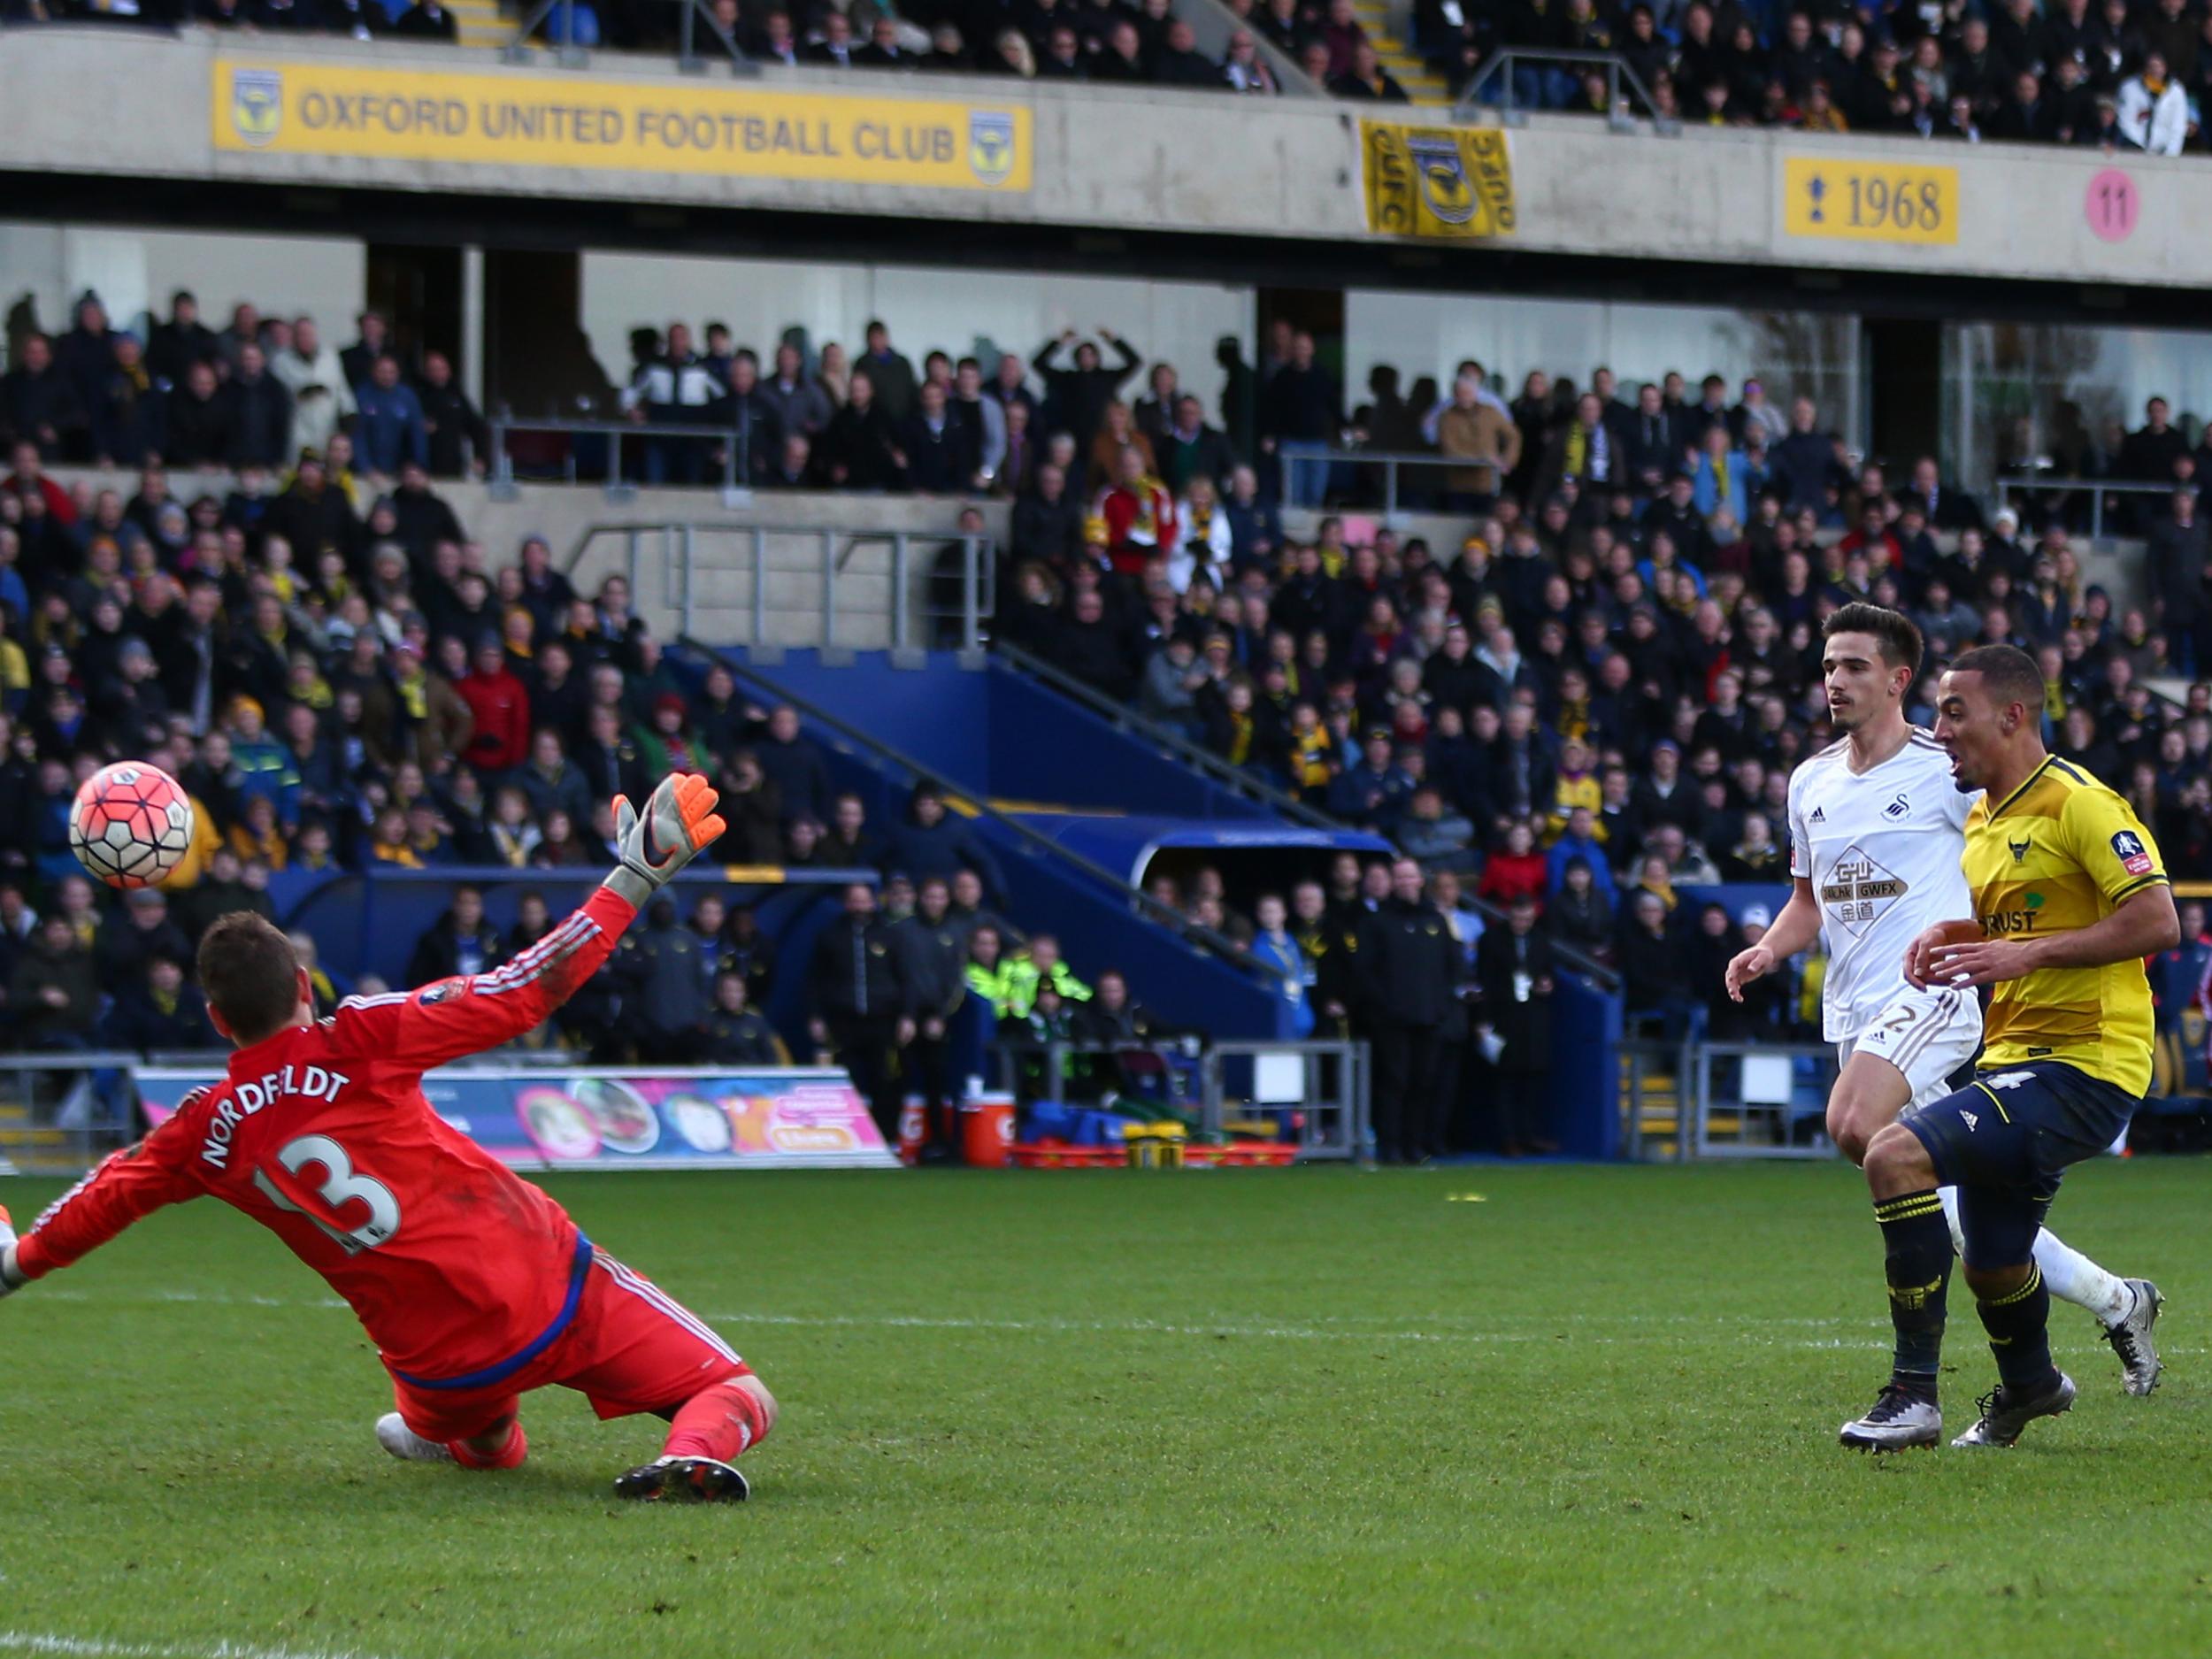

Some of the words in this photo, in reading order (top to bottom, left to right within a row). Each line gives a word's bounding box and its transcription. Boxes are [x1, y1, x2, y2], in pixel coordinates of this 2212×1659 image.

[299, 92, 467, 136] OXFORD
[482, 103, 622, 145] UNITED
[636, 111, 841, 158] FOOTBALL
[852, 121, 956, 164] CLUB
[1847, 177, 1941, 231] 1968
[2100, 184, 2128, 229] 11
[1860, 883, 1897, 897] GWFX
[201, 1064, 350, 1169] NORDFLDT
[253, 1133, 402, 1256] 13
